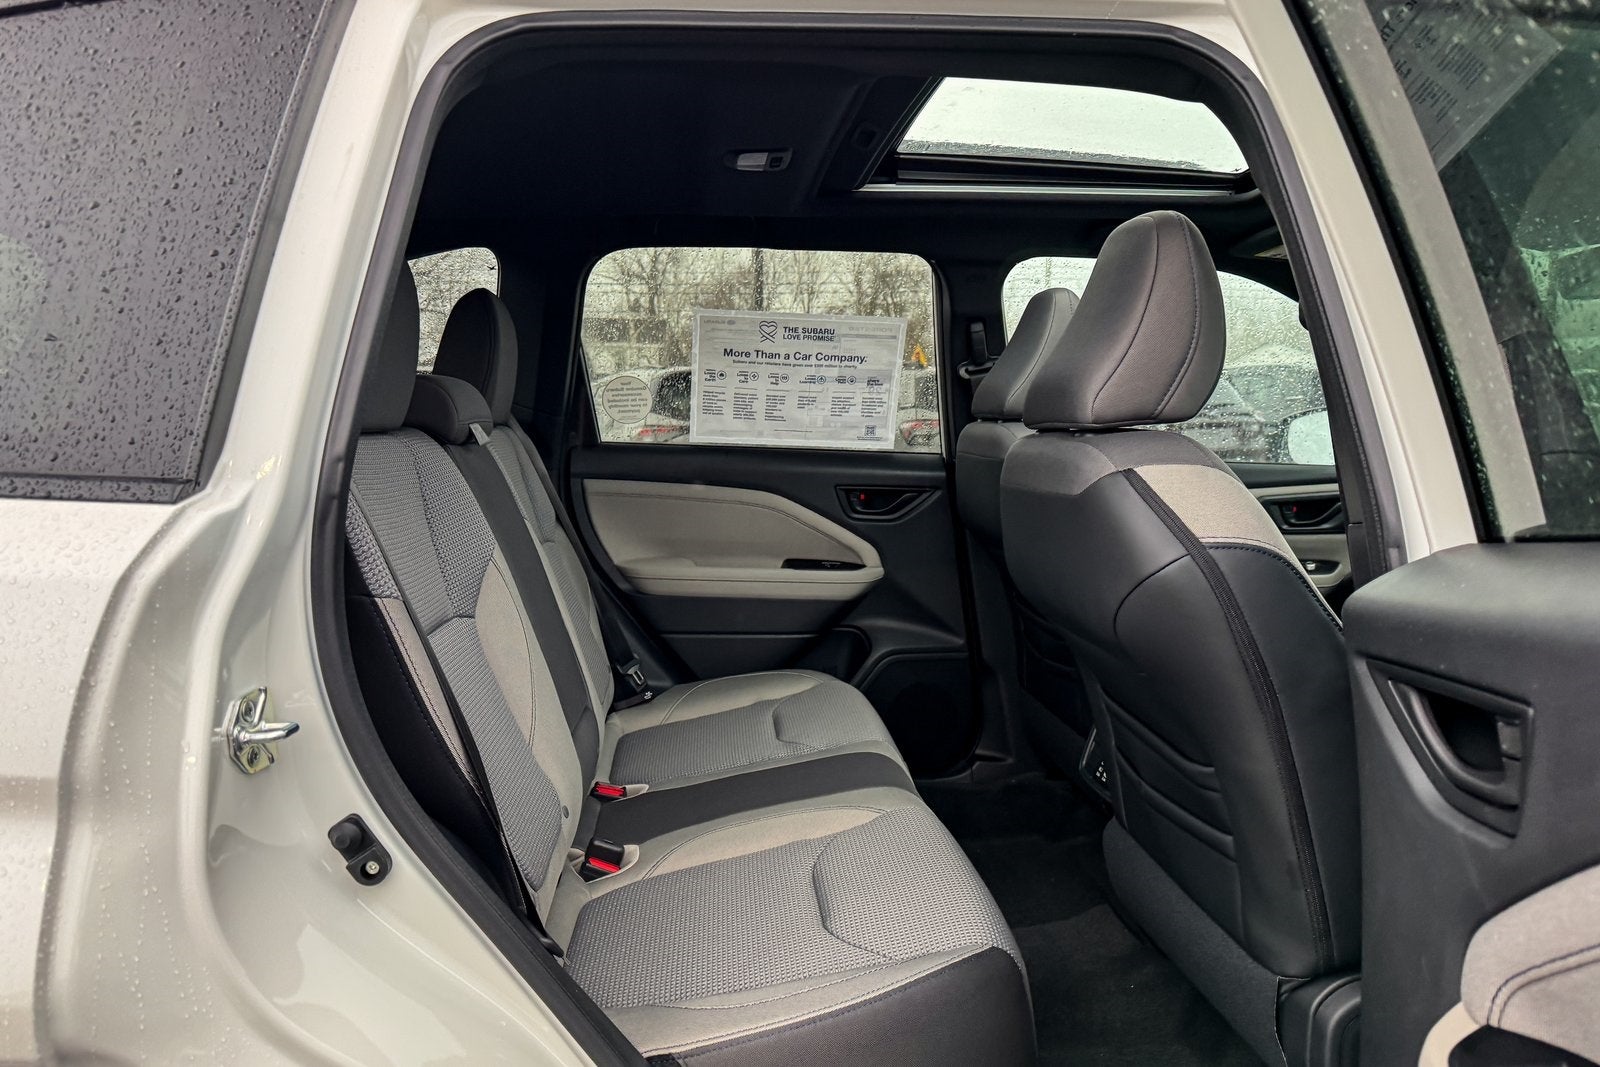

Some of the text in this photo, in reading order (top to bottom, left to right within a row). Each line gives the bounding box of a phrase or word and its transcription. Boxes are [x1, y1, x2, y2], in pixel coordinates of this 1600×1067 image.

[782, 326, 836, 336] THE SUBARU
[782, 333, 836, 342] LOVE PROMISE
[723, 348, 751, 359] More
[754, 349, 781, 360] Than
[793, 351, 813, 361] Car
